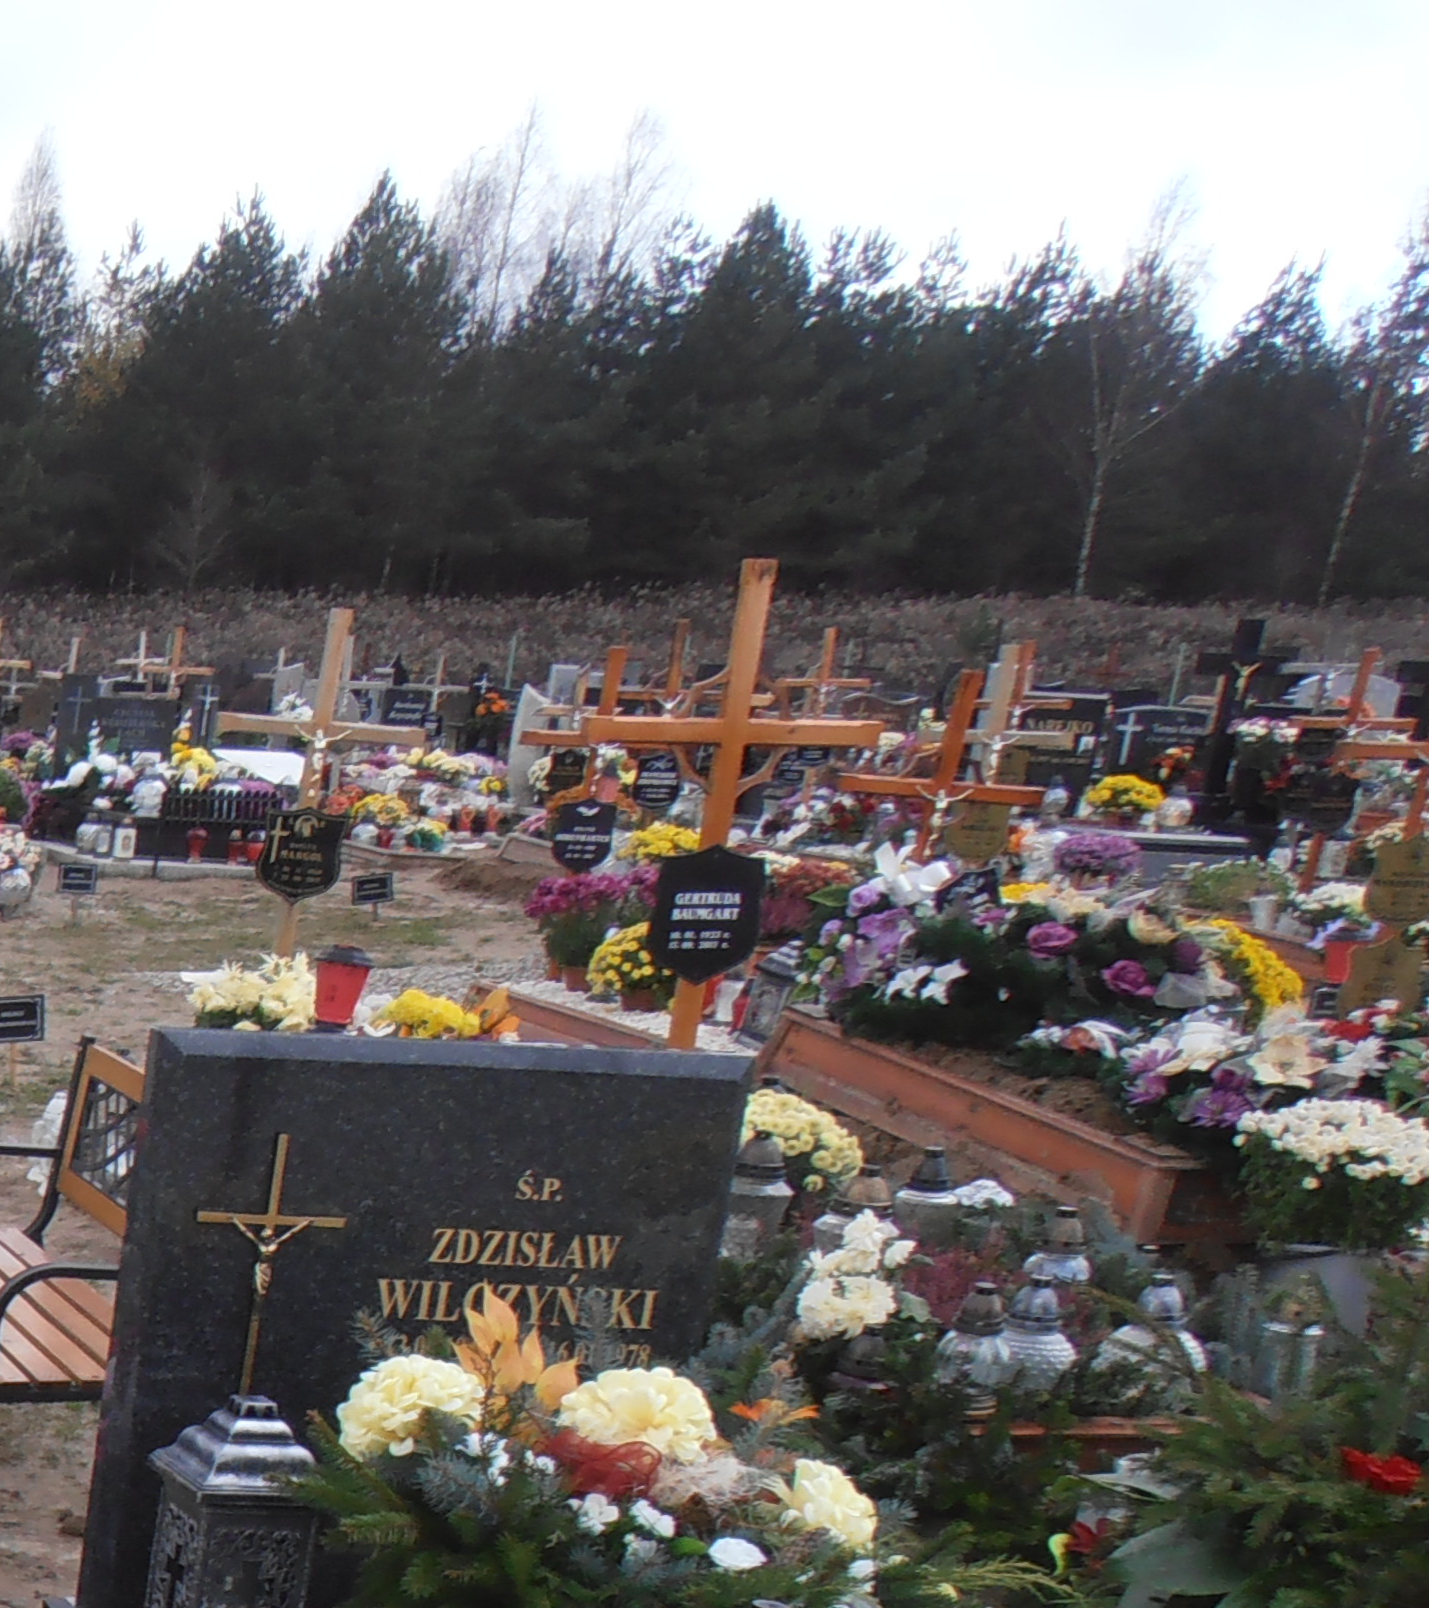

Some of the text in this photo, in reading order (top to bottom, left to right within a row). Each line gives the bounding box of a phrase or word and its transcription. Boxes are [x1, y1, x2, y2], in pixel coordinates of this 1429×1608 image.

[671, 908, 740, 920] BAUMGART
[674, 892, 741, 905] GERTRUDA
[515, 1169, 564, 1201] Ś.P.
[428, 1227, 624, 1269] ZDZISŁAW
[377, 1273, 659, 1330] WILCZYŃKI
